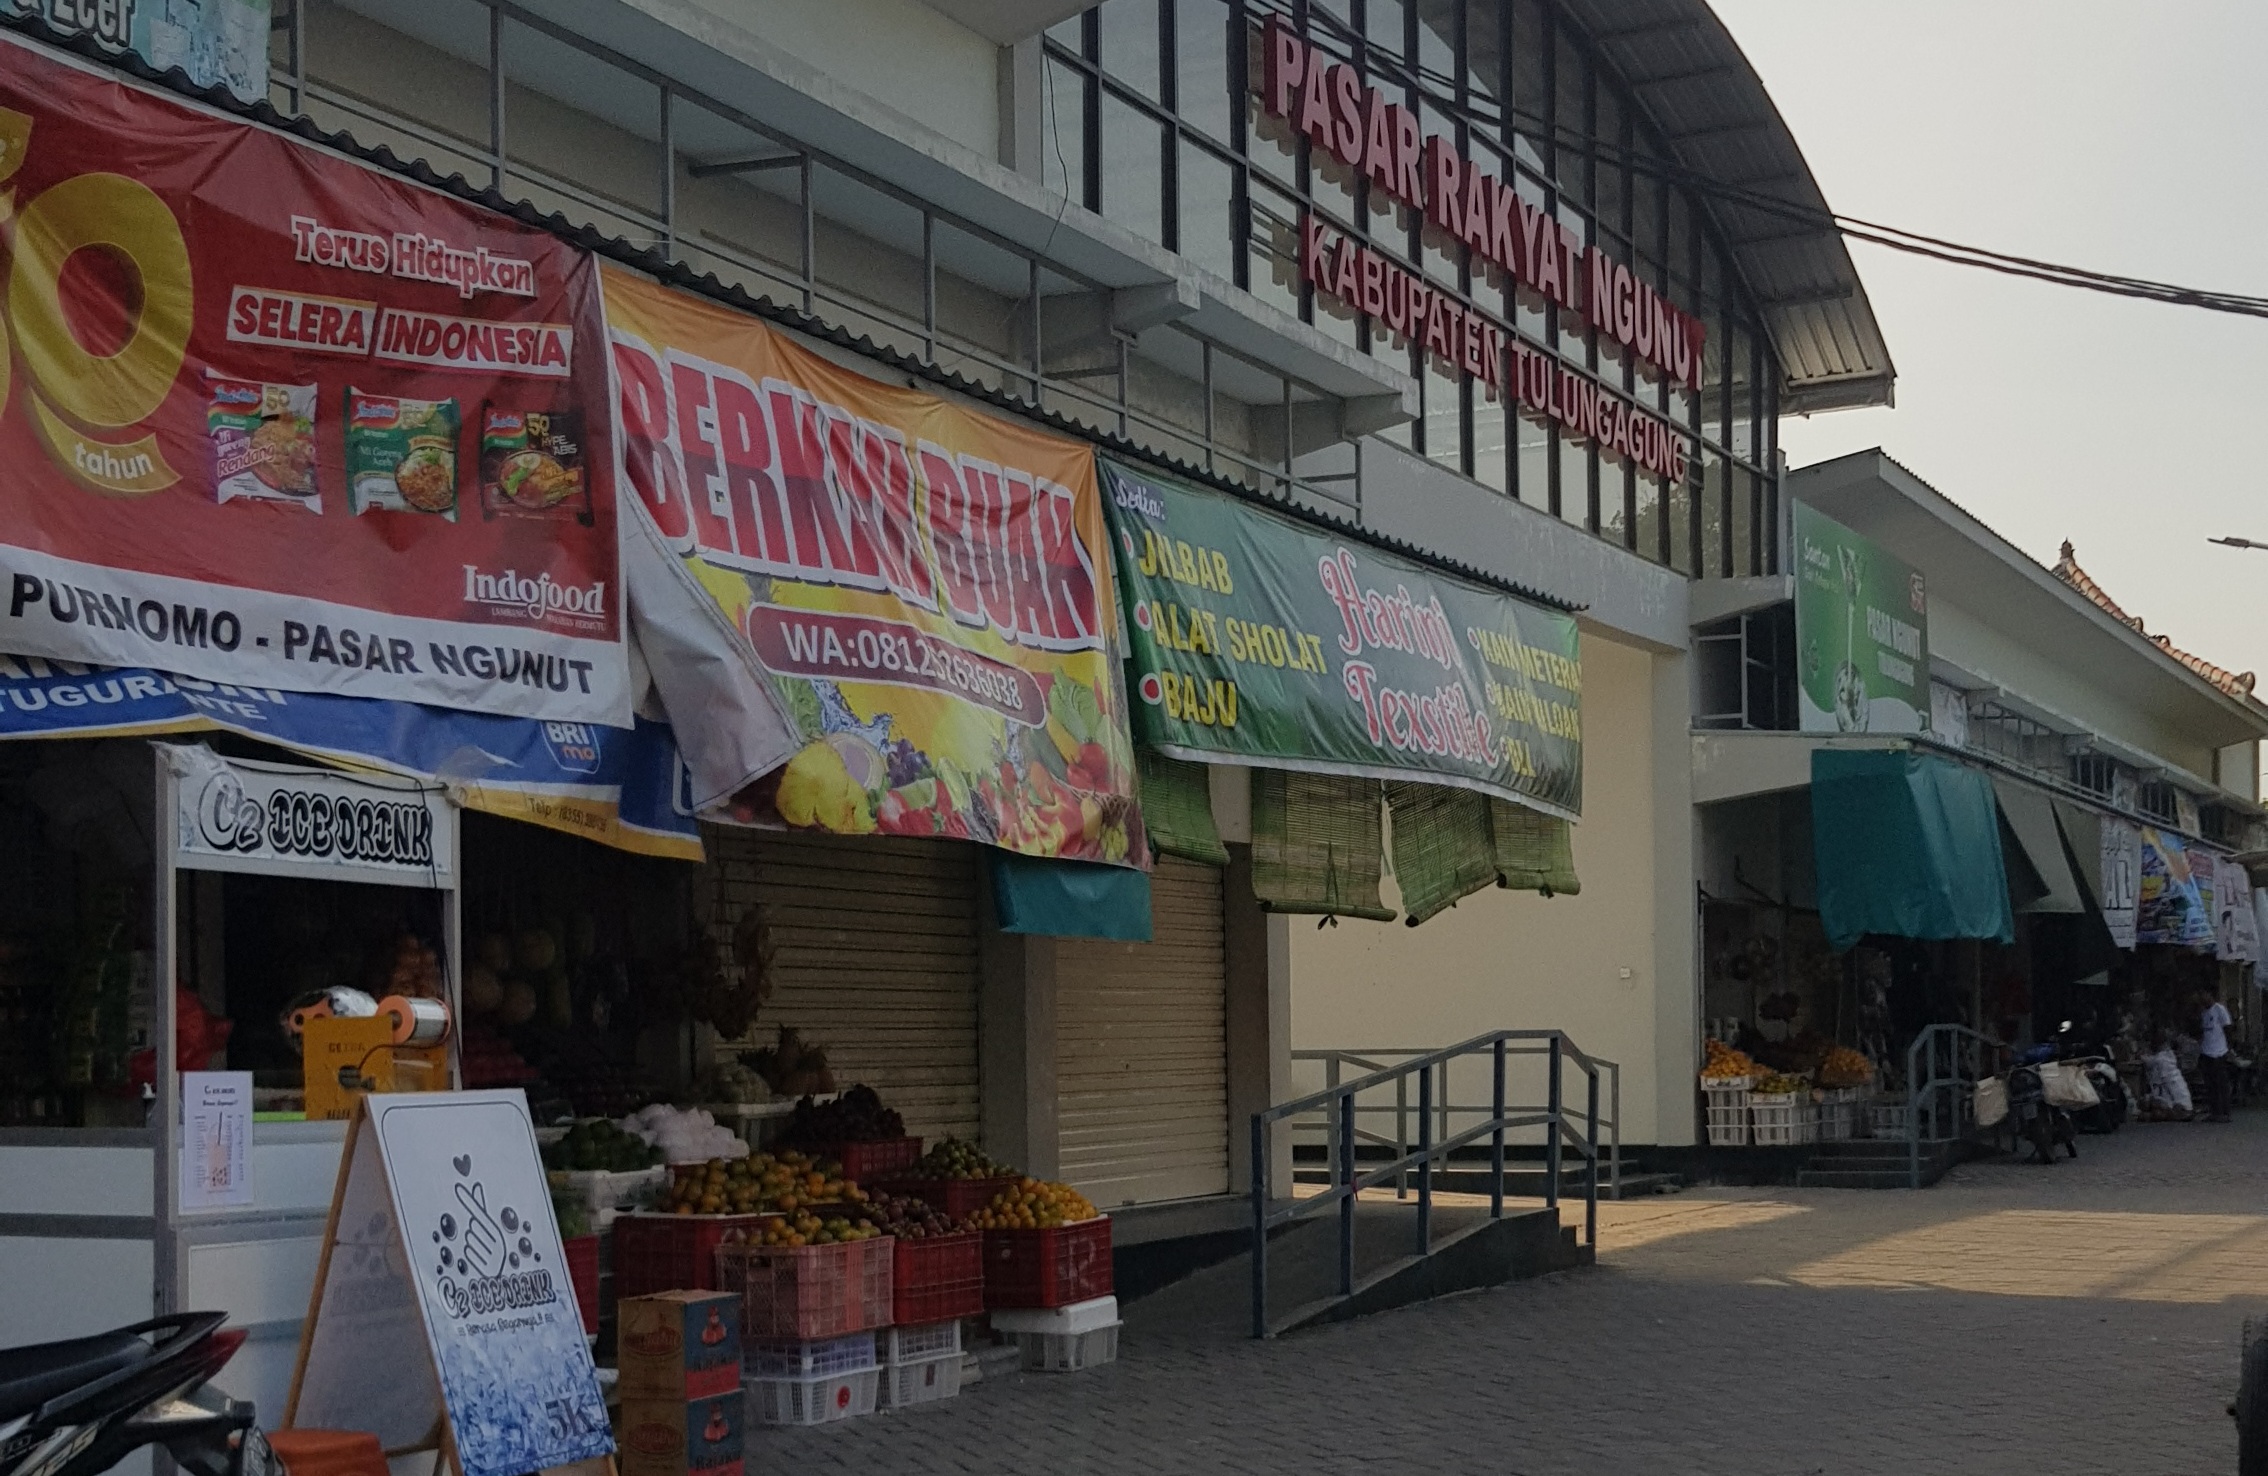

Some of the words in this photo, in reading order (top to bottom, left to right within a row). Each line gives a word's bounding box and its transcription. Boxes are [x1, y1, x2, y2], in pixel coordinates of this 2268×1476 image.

[1264, 13, 1422, 209] PASAR
[1427, 135, 1584, 309] RAKYAT
[291, 214, 391, 277] Terus
[391, 231, 535, 298] Hidupkan
[233, 297, 367, 350] SELERA
[381, 310, 568, 369] INDONESIA
[1304, 213, 1501, 386] KABUPATEN
[1511, 341, 1688, 484] TULUNGAGUNG
[75, 442, 154, 480] tahun
[218, 443, 276, 477] Rendang
[463, 565, 605, 619] Indofood
[1139, 530, 1233, 595] JILBAB
[10, 573, 241, 652] PURNOMO
[284, 620, 423, 674] PASAR
[428, 642, 594, 694] NGUNUT
[1152, 600, 1220, 655] ALAT
[1225, 617, 1328, 674] SHOLAT
[1161, 670, 1238, 728] BAJU
[546, 722, 590, 745] BRI
[267, 788, 333, 857] ICE
[335, 796, 433, 866] DRINK
[468, 1278, 506, 1315] ICE
[501, 1269, 557, 1309] DRINK
